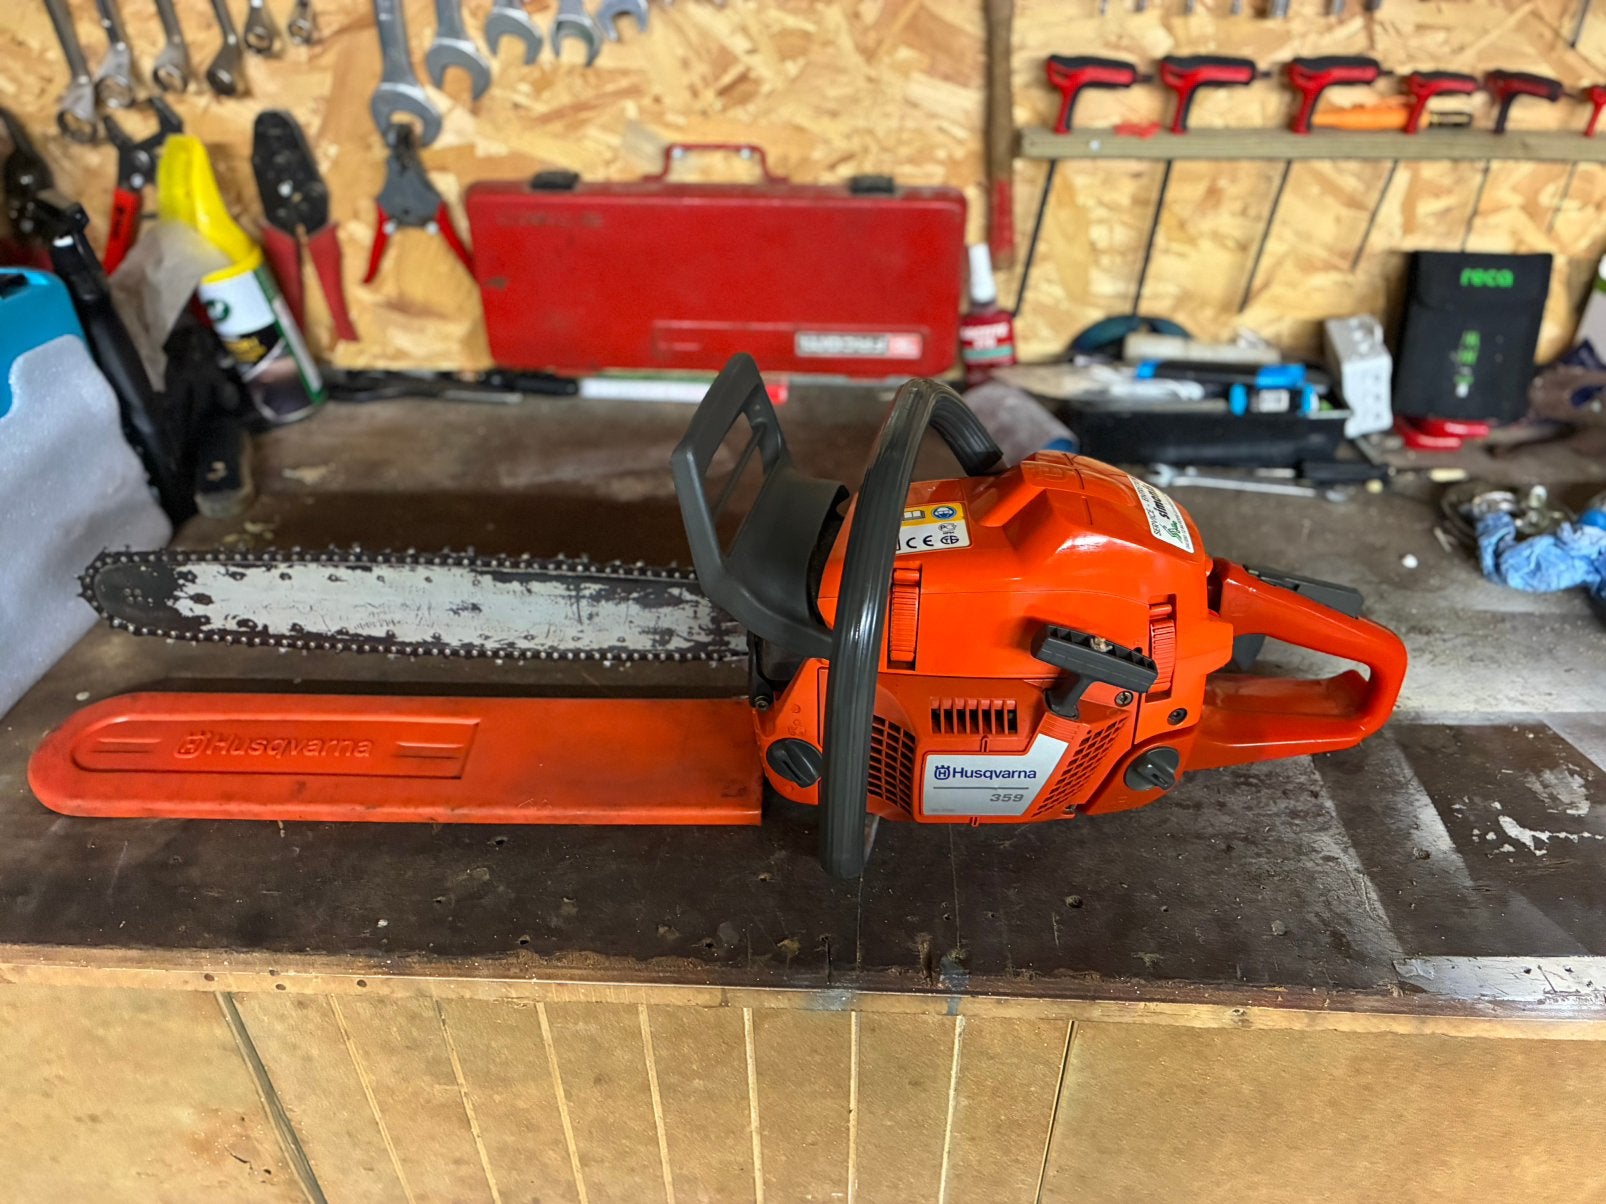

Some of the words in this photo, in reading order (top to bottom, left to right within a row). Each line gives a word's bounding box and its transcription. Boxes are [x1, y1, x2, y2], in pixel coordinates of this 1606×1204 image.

[205, 733, 374, 759] Husqvarna
[952, 767, 1037, 781] Husqvarna
[990, 793, 1025, 803] 359
